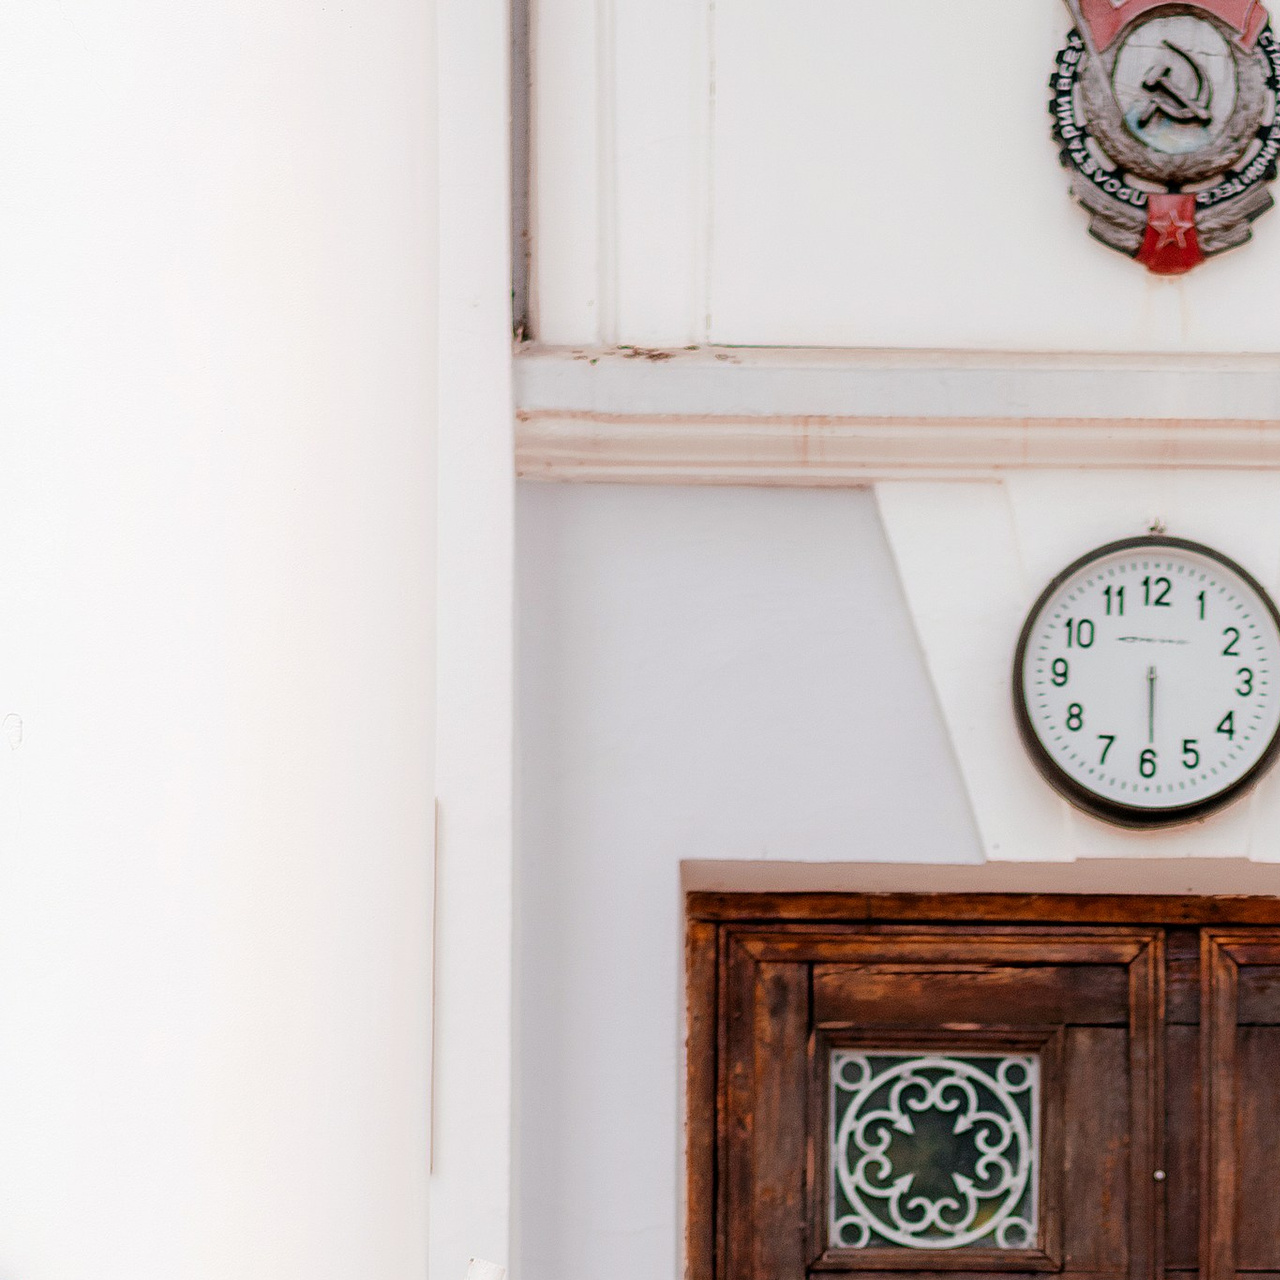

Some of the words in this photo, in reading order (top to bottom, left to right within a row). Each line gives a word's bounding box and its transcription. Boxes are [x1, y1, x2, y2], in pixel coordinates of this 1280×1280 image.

[1056, 35, 1084, 91] ВСЕХ
[1056, 95, 1149, 206] ПРОЛЕТАРИИ
[1103, 585, 1125, 616] 11
[1141, 575, 1172, 607] 12
[1197, 590, 1206, 620] 1
[1065, 617, 1095, 649] 10
[1222, 626, 1240, 657] 2
[1051, 657, 1069, 687] 9
[1235, 667, 1253, 697] 3
[1066, 702, 1083, 732] 8
[1216, 710, 1236, 741] 4
[1097, 735, 1116, 765] 7
[1139, 748, 1158, 778] 6
[1182, 739, 1200, 770] 5
